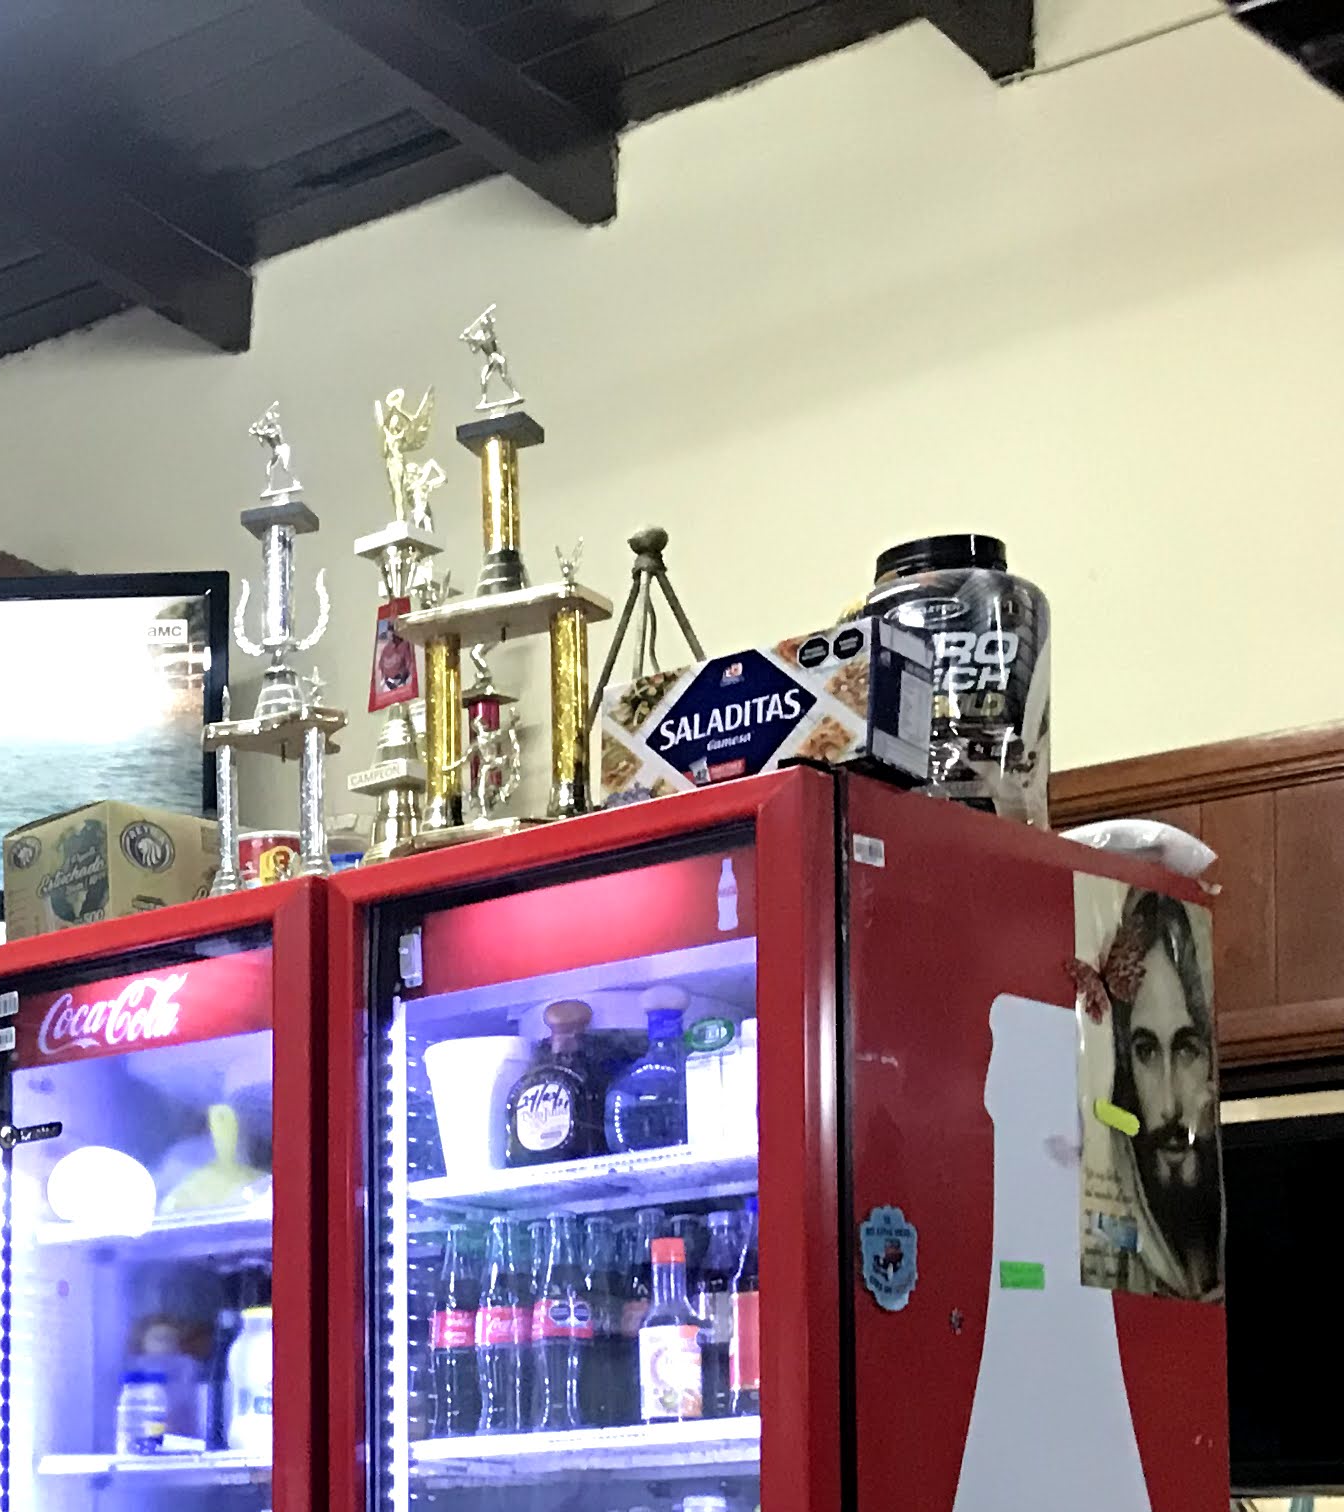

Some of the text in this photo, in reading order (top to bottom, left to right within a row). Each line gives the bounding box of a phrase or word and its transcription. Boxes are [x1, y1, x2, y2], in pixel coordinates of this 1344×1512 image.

[147, 625, 182, 637] aMC
[932, 631, 1019, 665] RO
[933, 665, 1011, 691] CH
[659, 687, 802, 752] SALADITAS
[706, 731, 753, 752] Gamesa
[37, 972, 188, 1055] Coca-Cola
